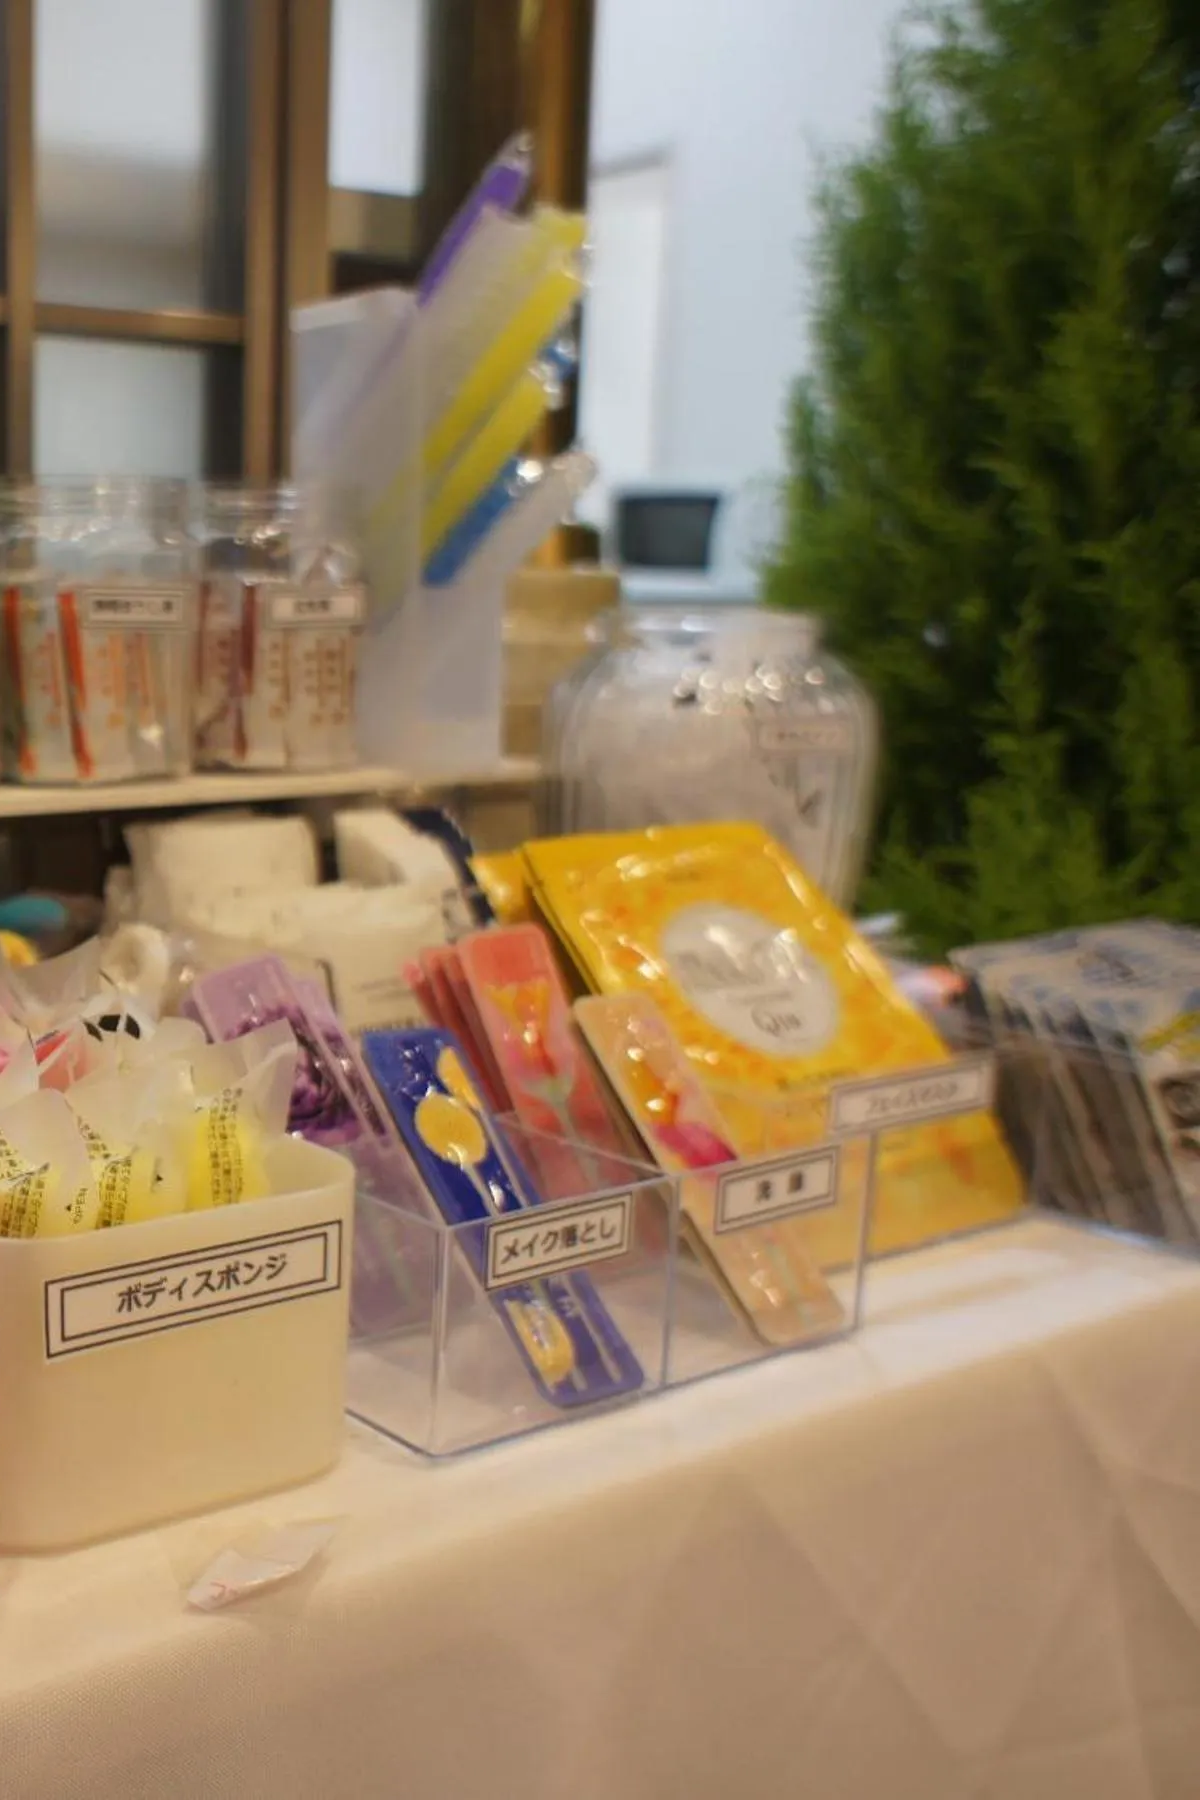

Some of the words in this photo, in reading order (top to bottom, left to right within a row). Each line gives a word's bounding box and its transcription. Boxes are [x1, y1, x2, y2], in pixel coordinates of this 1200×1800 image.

[500, 1216, 617, 1265] メイク落とし
[116, 1253, 288, 1313] ボディスポンジ
